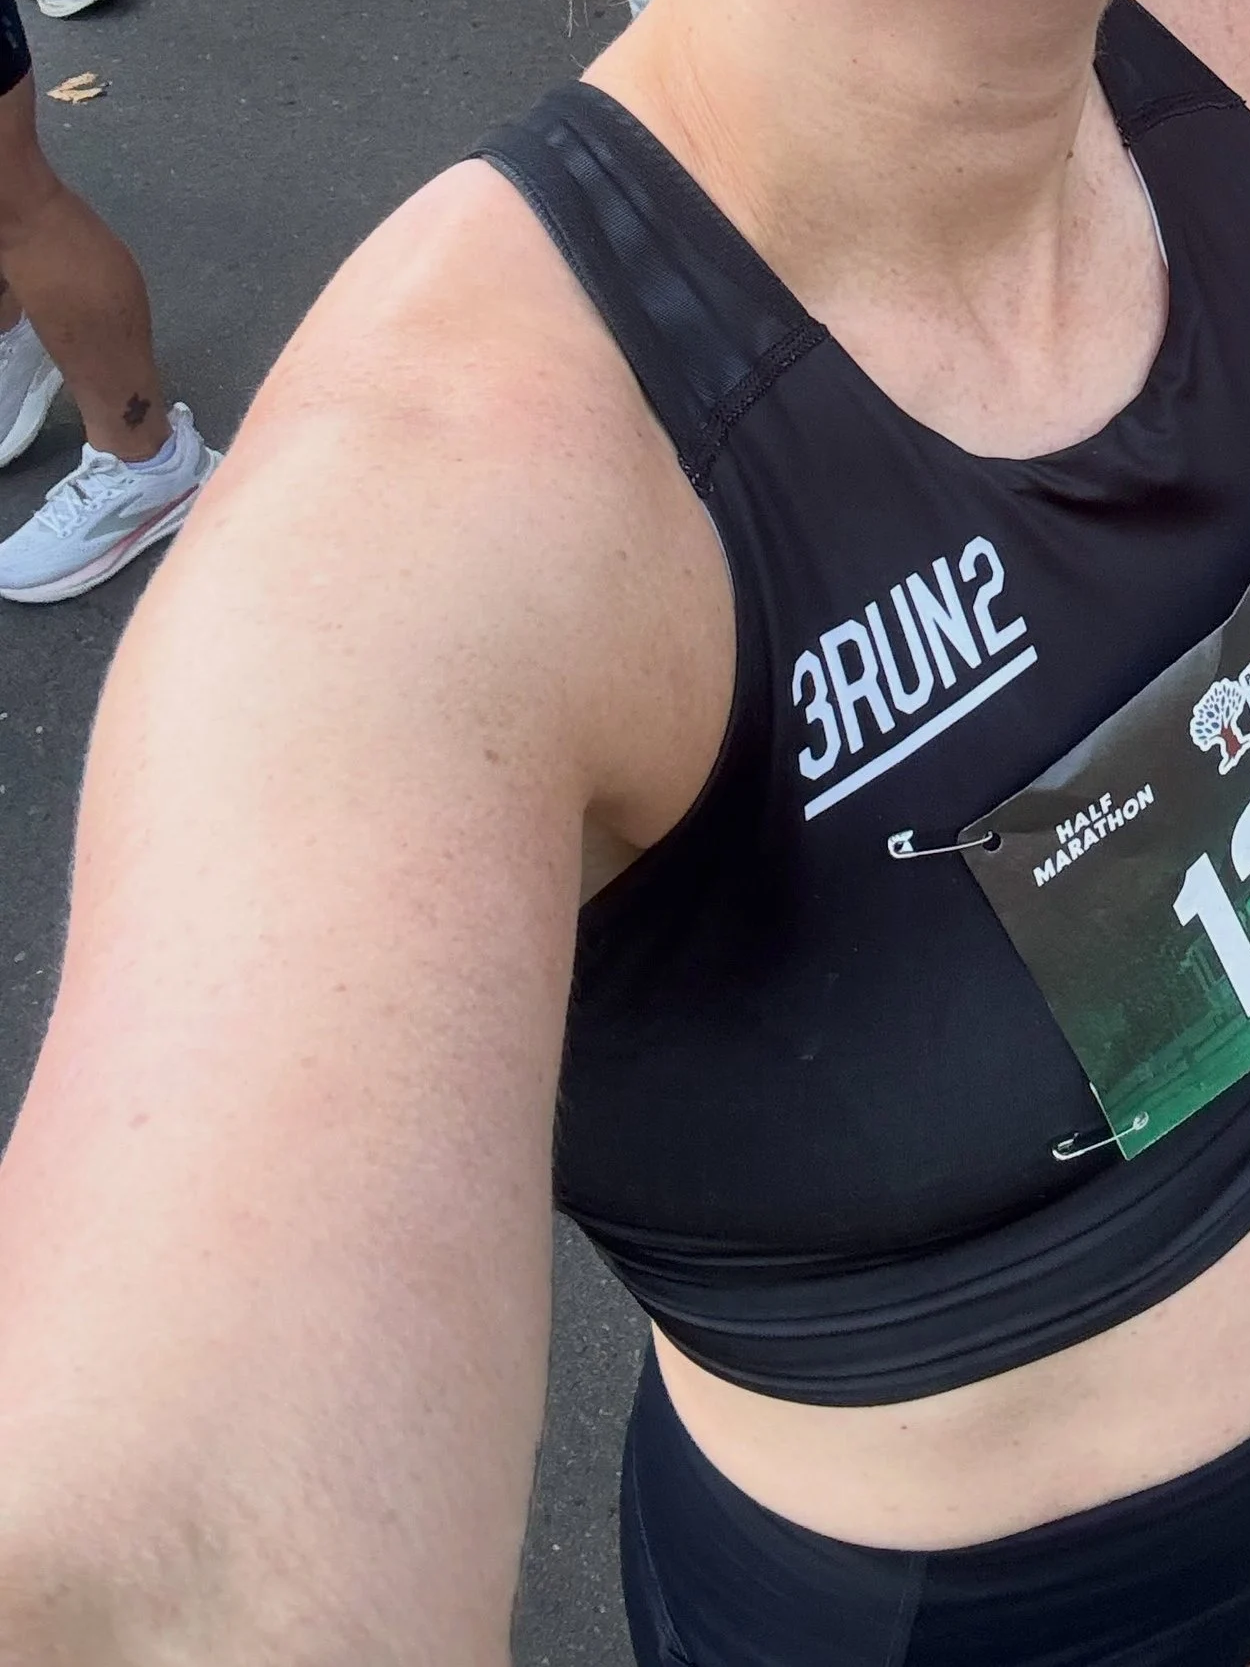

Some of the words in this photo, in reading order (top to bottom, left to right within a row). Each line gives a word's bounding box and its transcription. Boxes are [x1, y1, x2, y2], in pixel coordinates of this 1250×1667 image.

[791, 535, 1029, 781] 3RUN2
[1032, 783, 1155, 888] MARATHON
[1055, 792, 1113, 845] HALF
